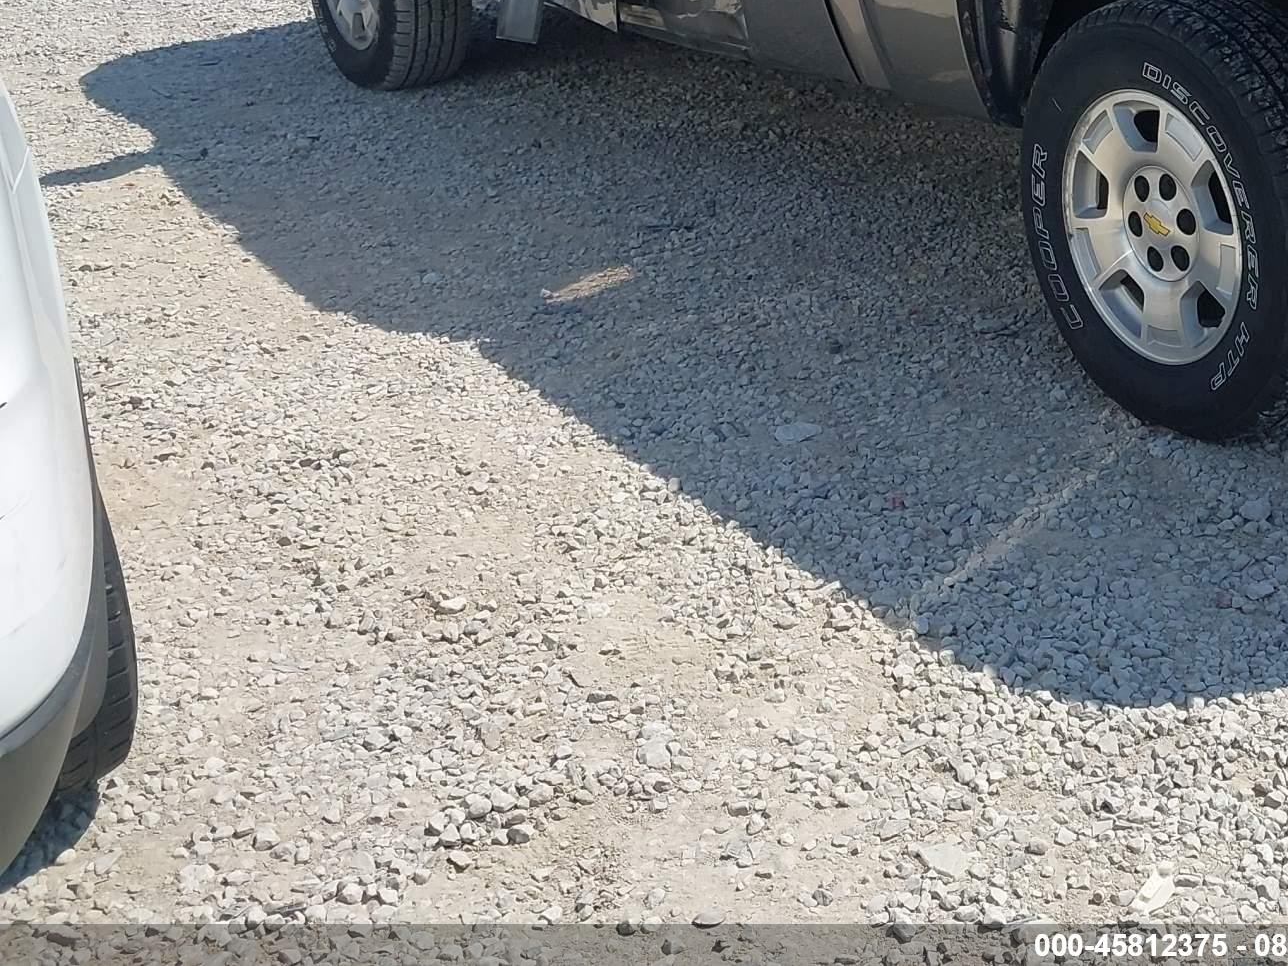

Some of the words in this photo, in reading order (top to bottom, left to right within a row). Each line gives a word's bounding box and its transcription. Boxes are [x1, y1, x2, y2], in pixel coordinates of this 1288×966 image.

[1031, 143, 1084, 331] COOPER
[1142, 61, 1261, 311] DISCOVERER
[1211, 321, 1251, 391] HTP
